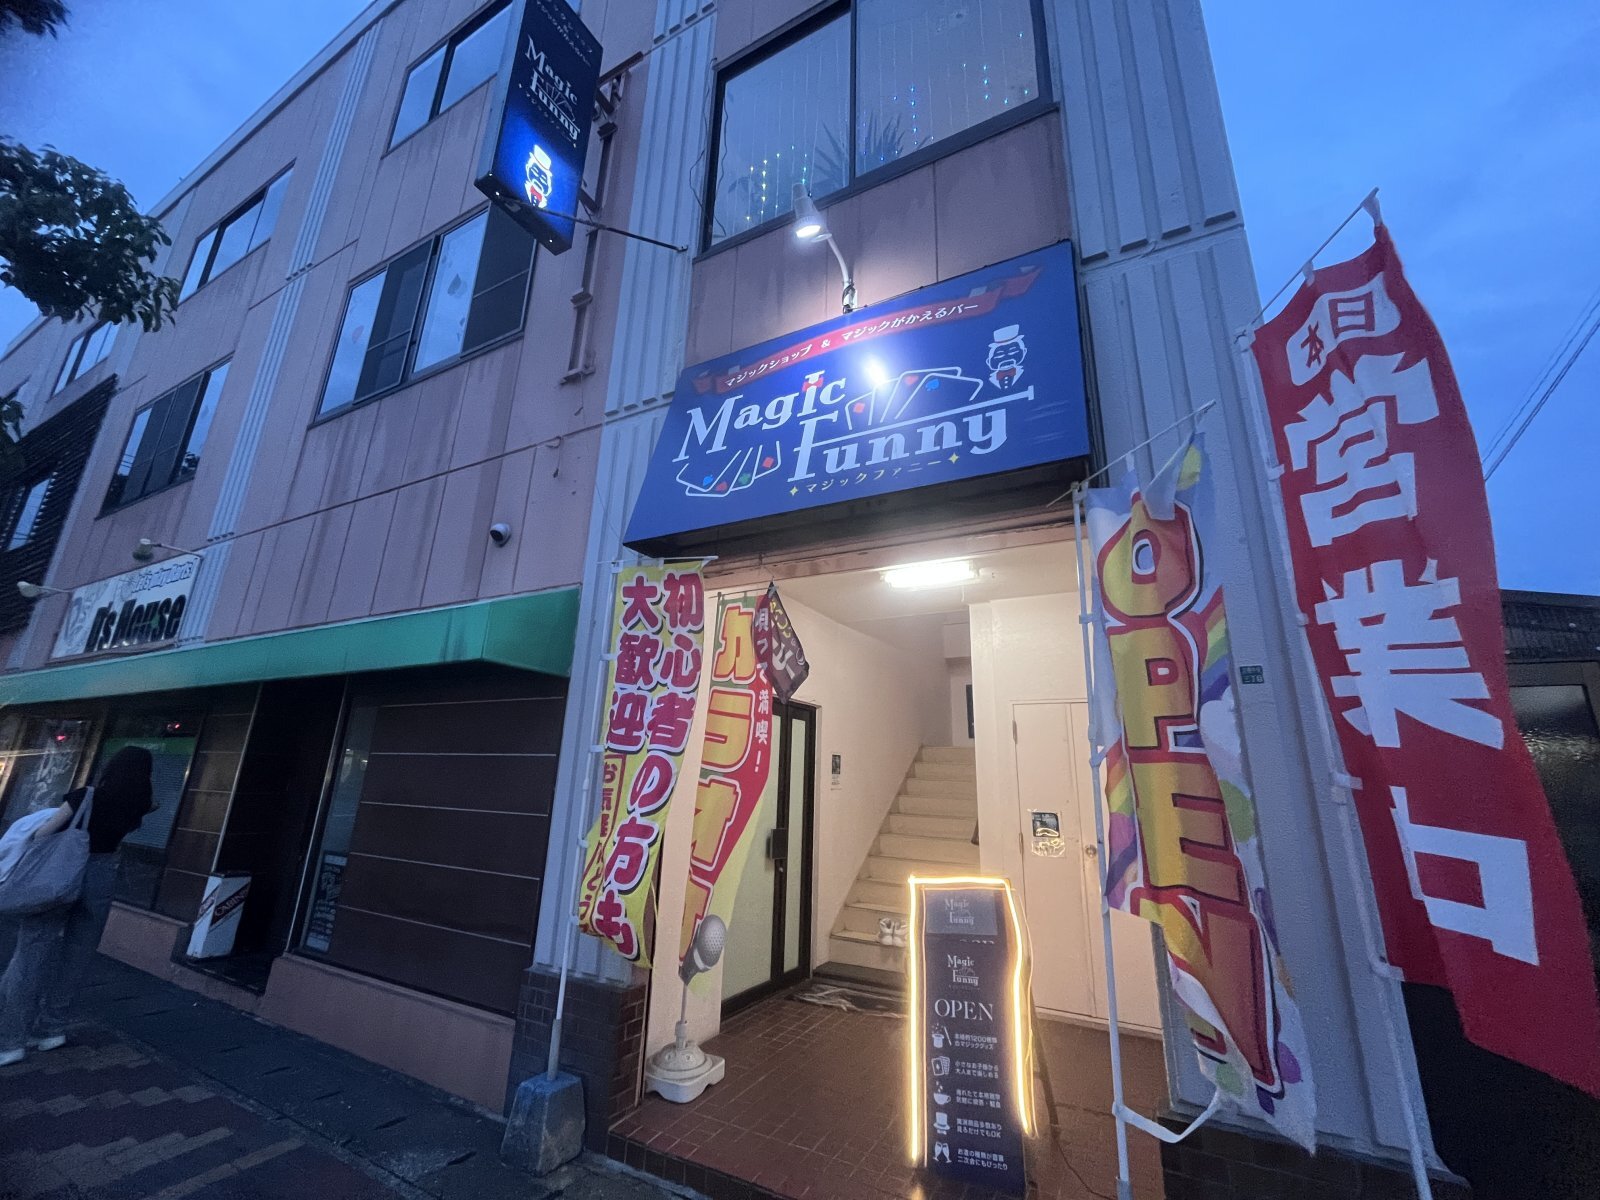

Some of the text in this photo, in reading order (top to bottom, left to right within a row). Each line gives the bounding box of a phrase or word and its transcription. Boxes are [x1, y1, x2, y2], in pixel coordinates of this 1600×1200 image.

[525, 35, 578, 105] Magic
[530, 69, 580, 140] Funny
[725, 303, 979, 387] マジックショップ & マジックがかえるバー
[672, 370, 847, 462] Magic
[787, 385, 1034, 483] Funny
[807, 459, 942, 493] マジックファニー
[605, 575, 659, 747] 大歓迎
[947, 954, 975, 968] Magic
[952, 969, 979, 987] Funny
[934, 998, 993, 1021] OPEN
